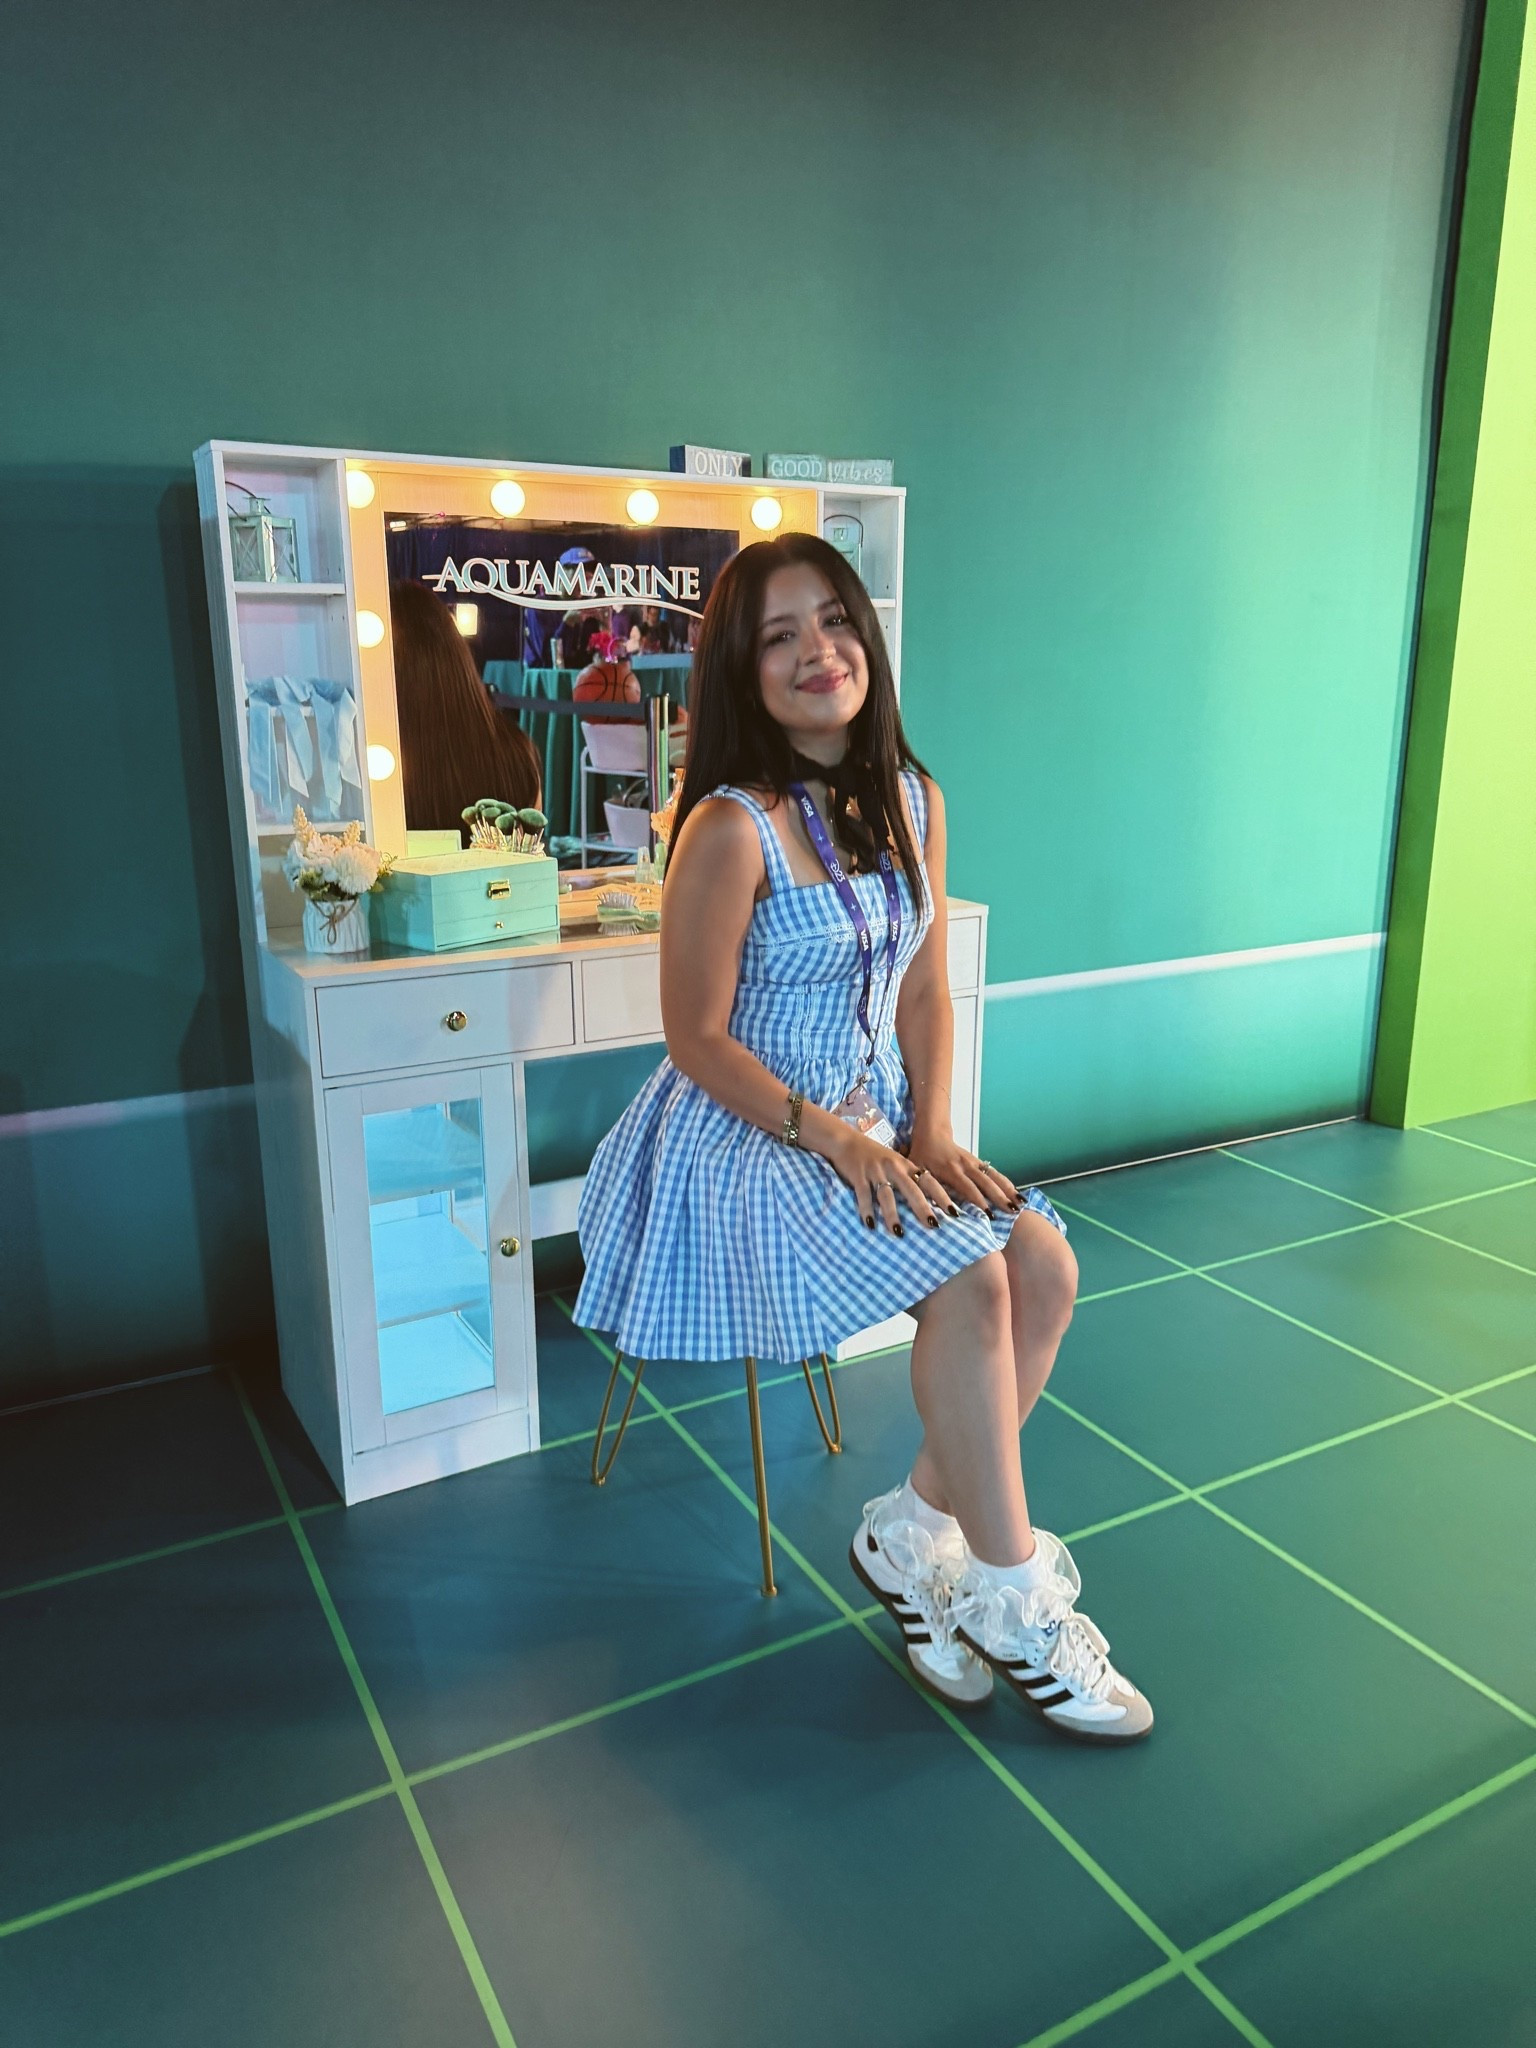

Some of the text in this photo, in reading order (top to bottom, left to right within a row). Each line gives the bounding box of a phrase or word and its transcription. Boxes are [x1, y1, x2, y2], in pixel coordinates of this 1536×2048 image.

[694, 450, 745, 477] ONLY
[770, 459, 823, 479] GOOD
[432, 556, 701, 604] AQUAMARINE
[800, 796, 815, 818] VISA
[859, 927, 870, 952] VISA
[891, 920, 899, 943] VISA
